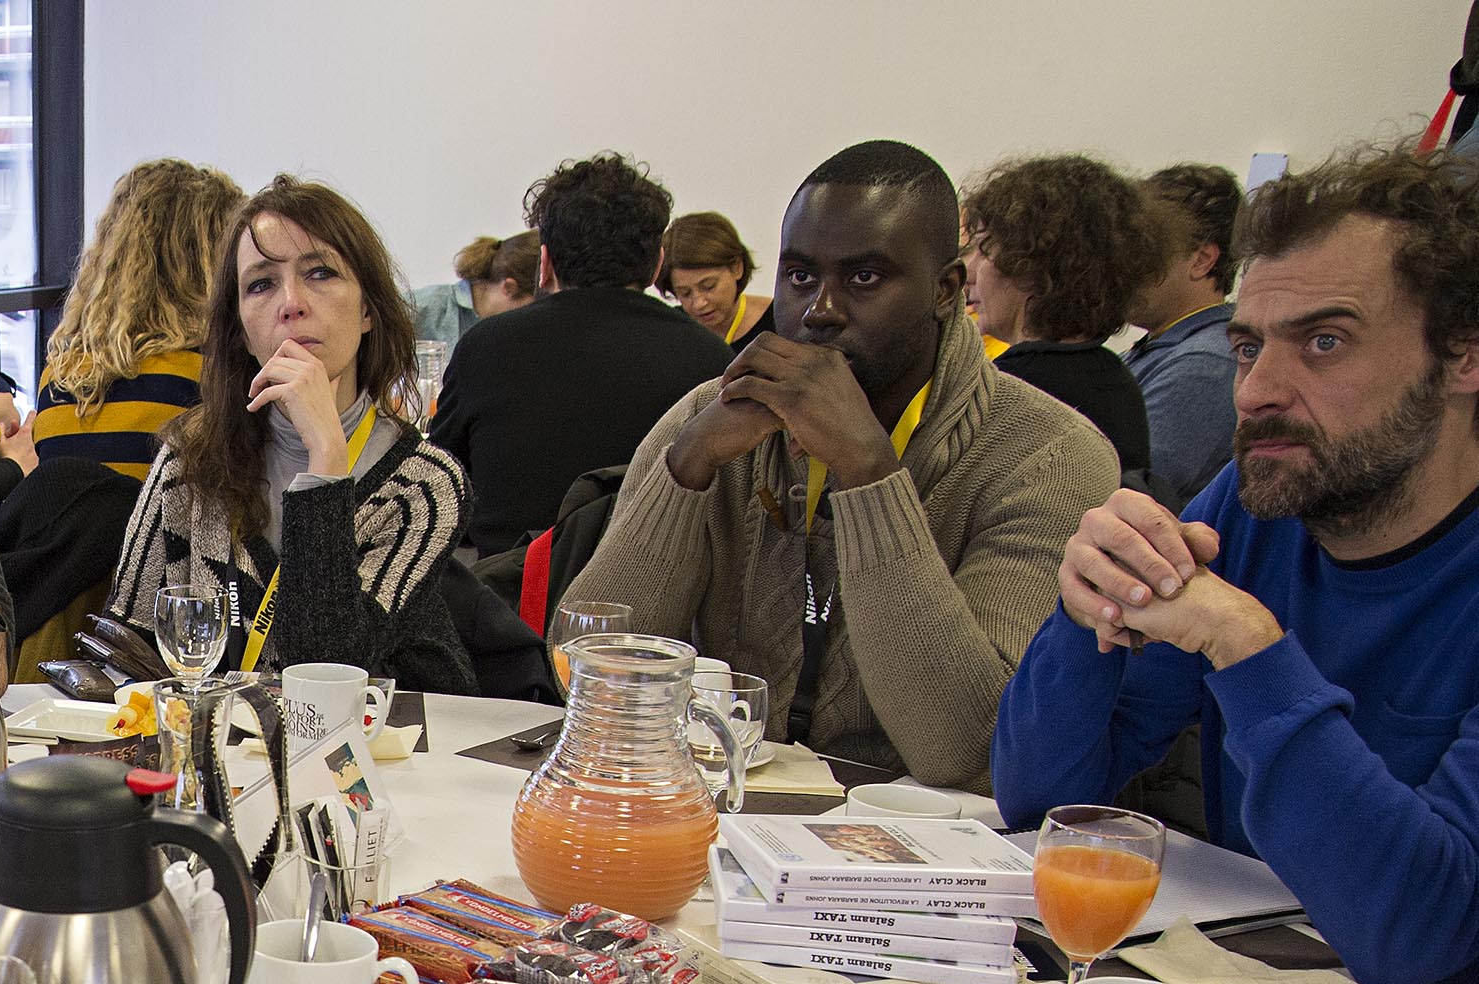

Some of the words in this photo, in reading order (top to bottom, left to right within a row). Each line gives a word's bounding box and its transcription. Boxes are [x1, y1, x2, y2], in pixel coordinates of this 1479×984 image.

[228, 581, 241, 627] Nikon
[805, 573, 817, 625] Nikon
[283, 697, 316, 718] PLUS
[928, 877, 954, 886] CLAY
[955, 878, 987, 887] BLACK
[926, 899, 952, 908] CLAY
[954, 901, 986, 909] BLACK
[813, 911, 847, 923] TAXI
[849, 915, 896, 927] Salaam
[809, 931, 843, 944] TAXI
[845, 935, 891, 948] Salaam
[810, 954, 844, 966] TAXI
[846, 958, 893, 971] Salaam
